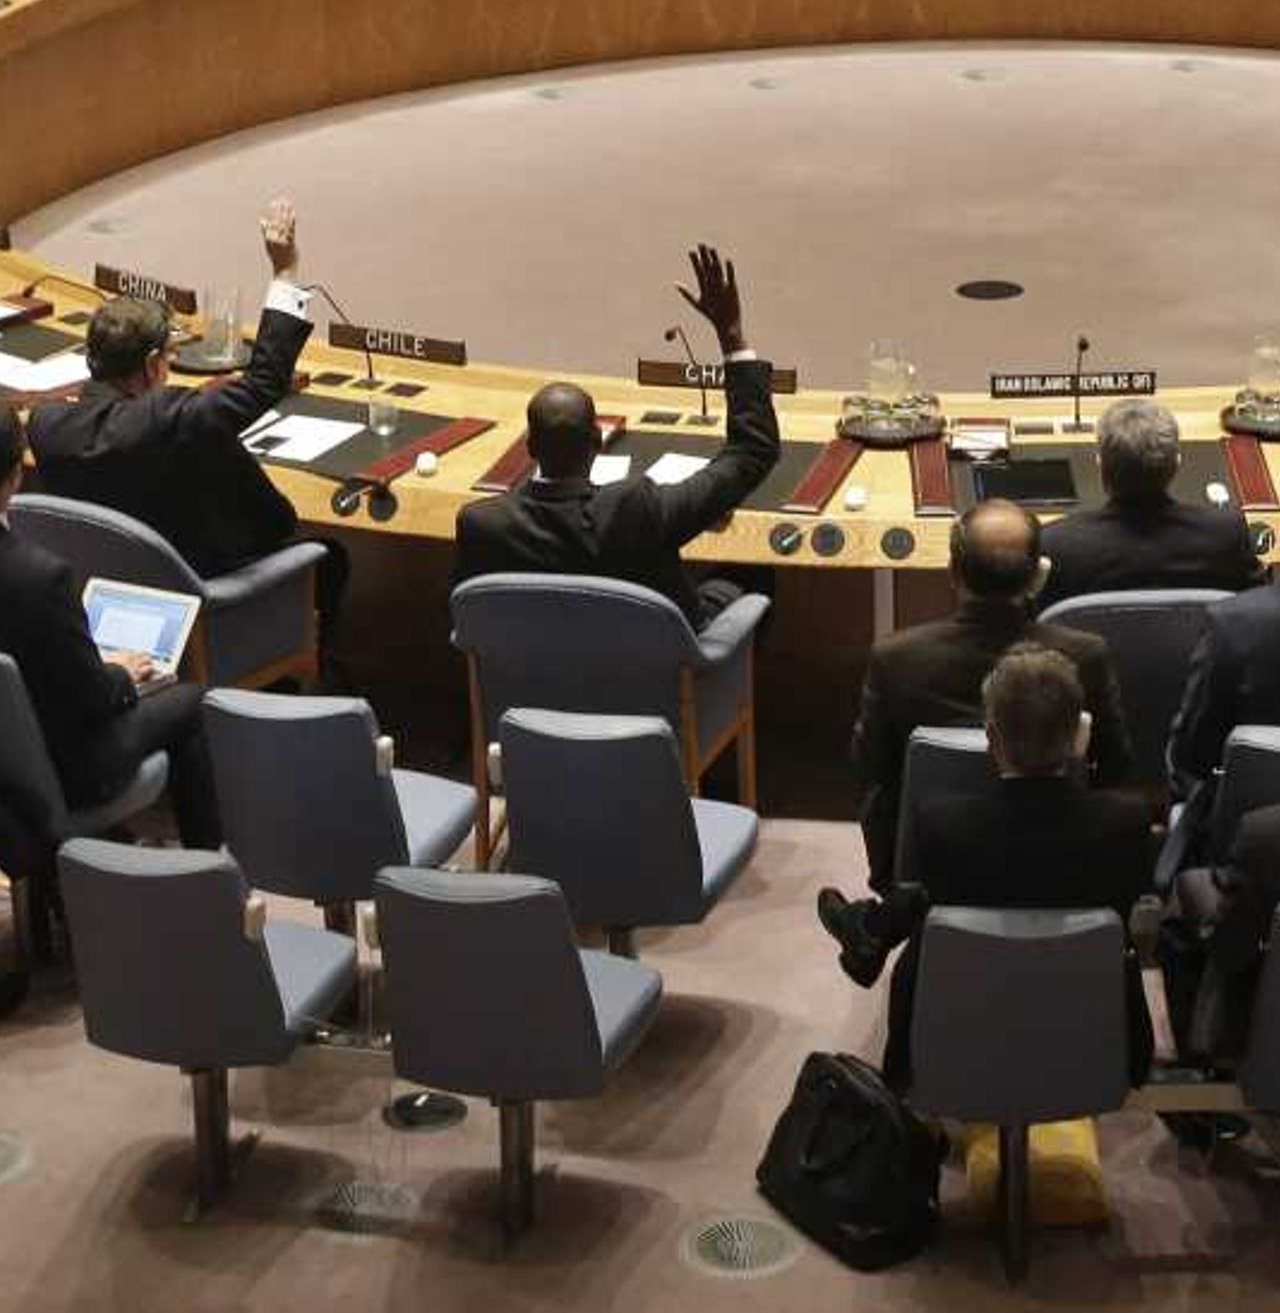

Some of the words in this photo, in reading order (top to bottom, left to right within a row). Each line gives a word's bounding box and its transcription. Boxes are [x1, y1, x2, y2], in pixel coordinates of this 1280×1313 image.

[119, 272, 166, 301] CHINA
[366, 329, 425, 356] CHILE
[685, 364, 725, 385] CHA
[994, 377, 1021, 392] IRAN
